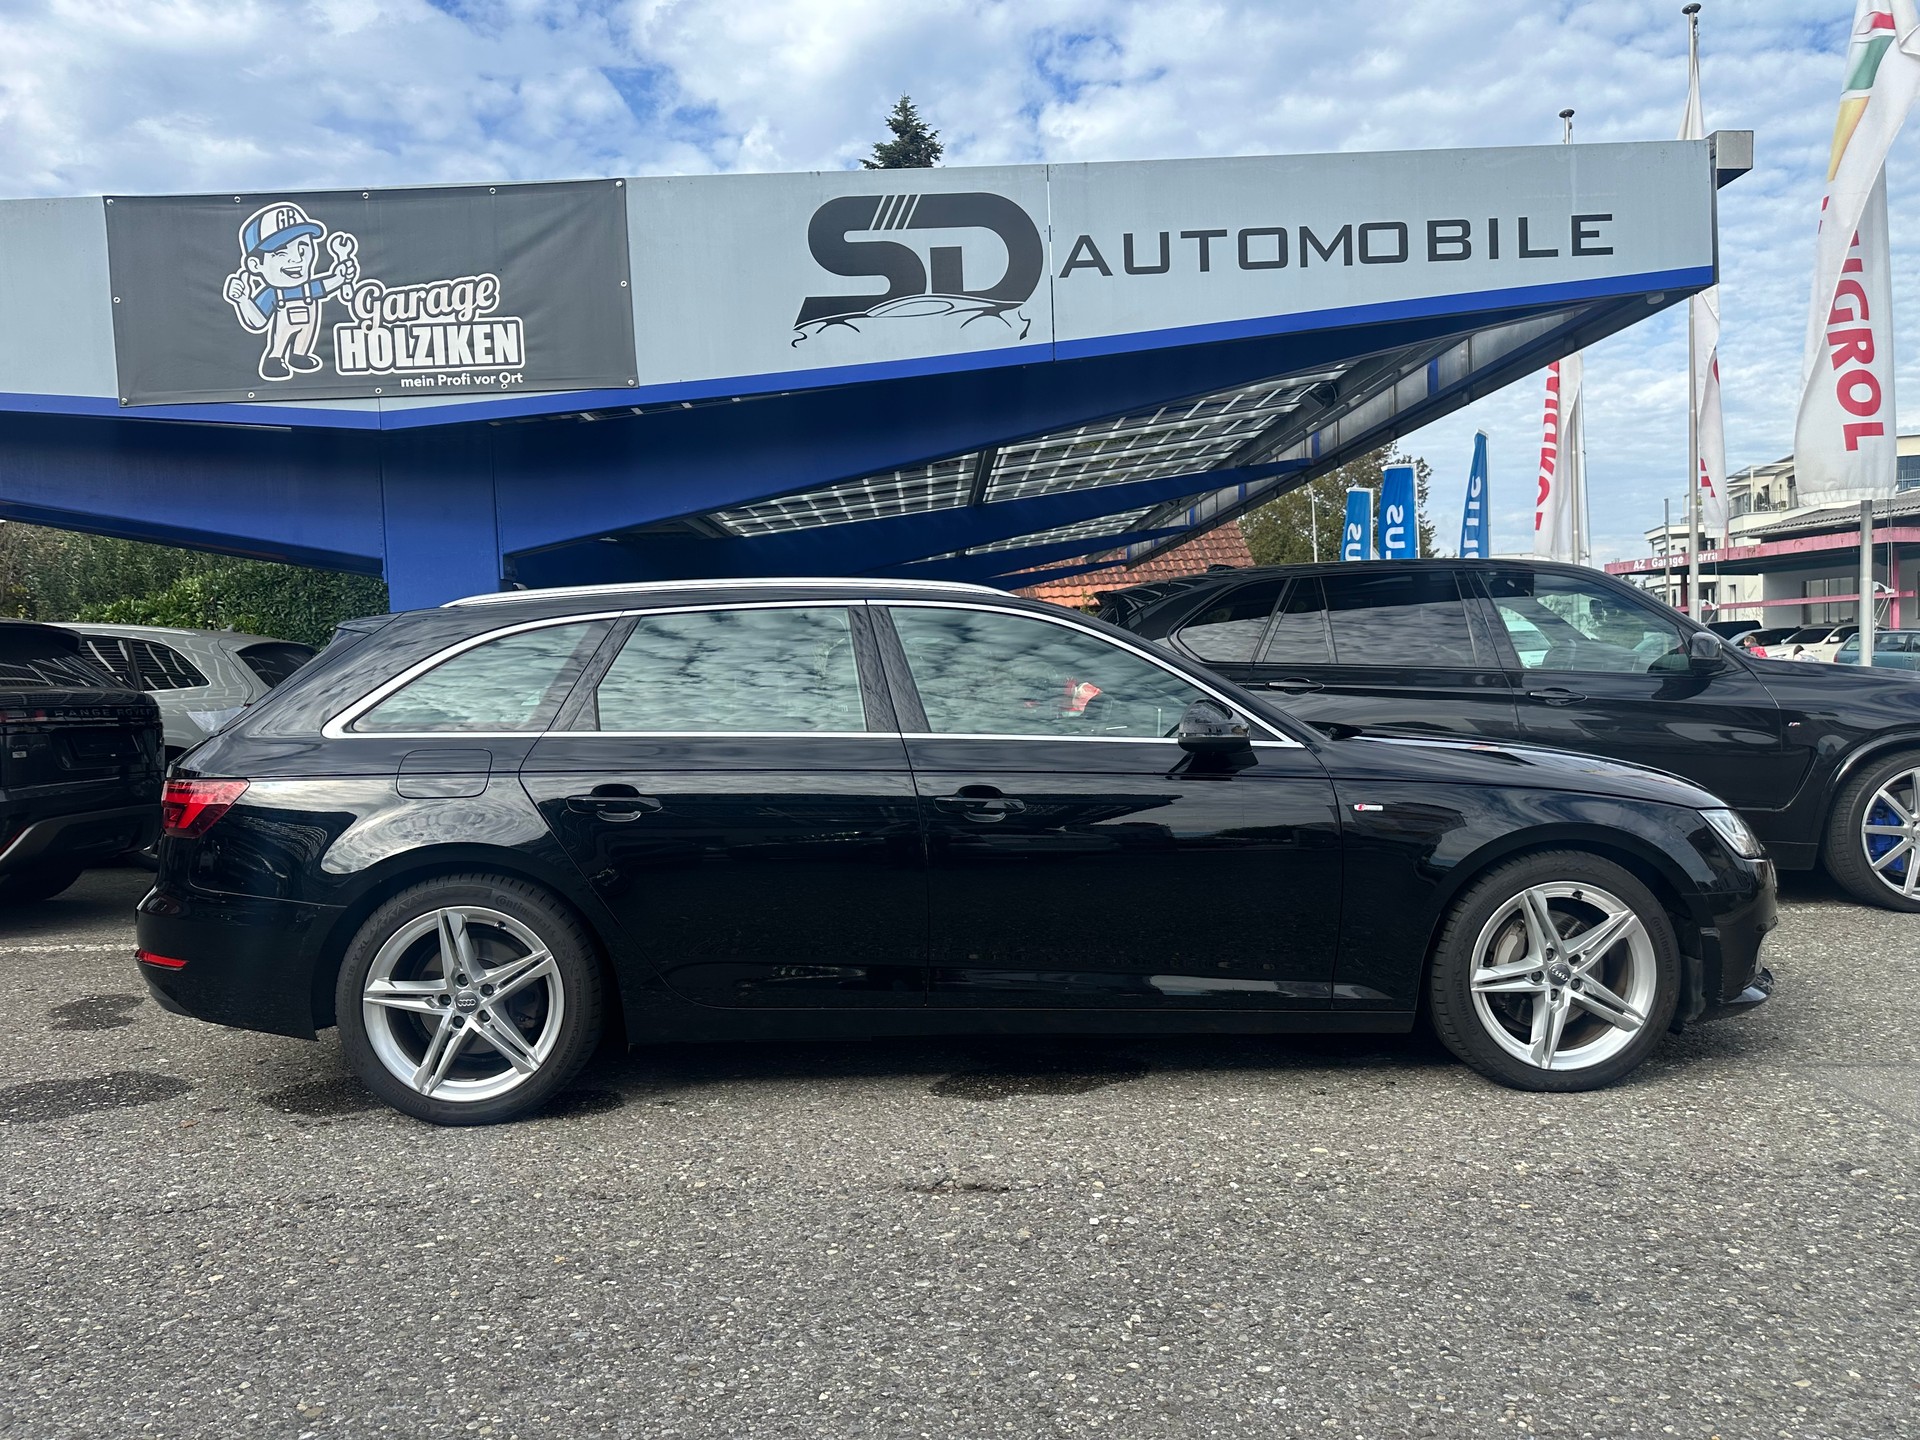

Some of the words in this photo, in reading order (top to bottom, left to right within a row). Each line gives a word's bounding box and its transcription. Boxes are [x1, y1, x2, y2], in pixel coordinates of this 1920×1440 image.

[276, 208, 297, 231] GB
[1058, 213, 1614, 279] AUTOMOBILE
[355, 276, 496, 334] Garage
[339, 322, 521, 369] HOLZIKEN
[1827, 230, 1885, 452] IGROL
[400, 375, 434, 388] mein
[438, 373, 471, 387] Profi
[473, 375, 496, 386] vor
[499, 371, 523, 384] Ort
[1633, 560, 1645, 570] AZ
[1691, 552, 1718, 562] arra
[54, 708, 111, 717] RANGE
